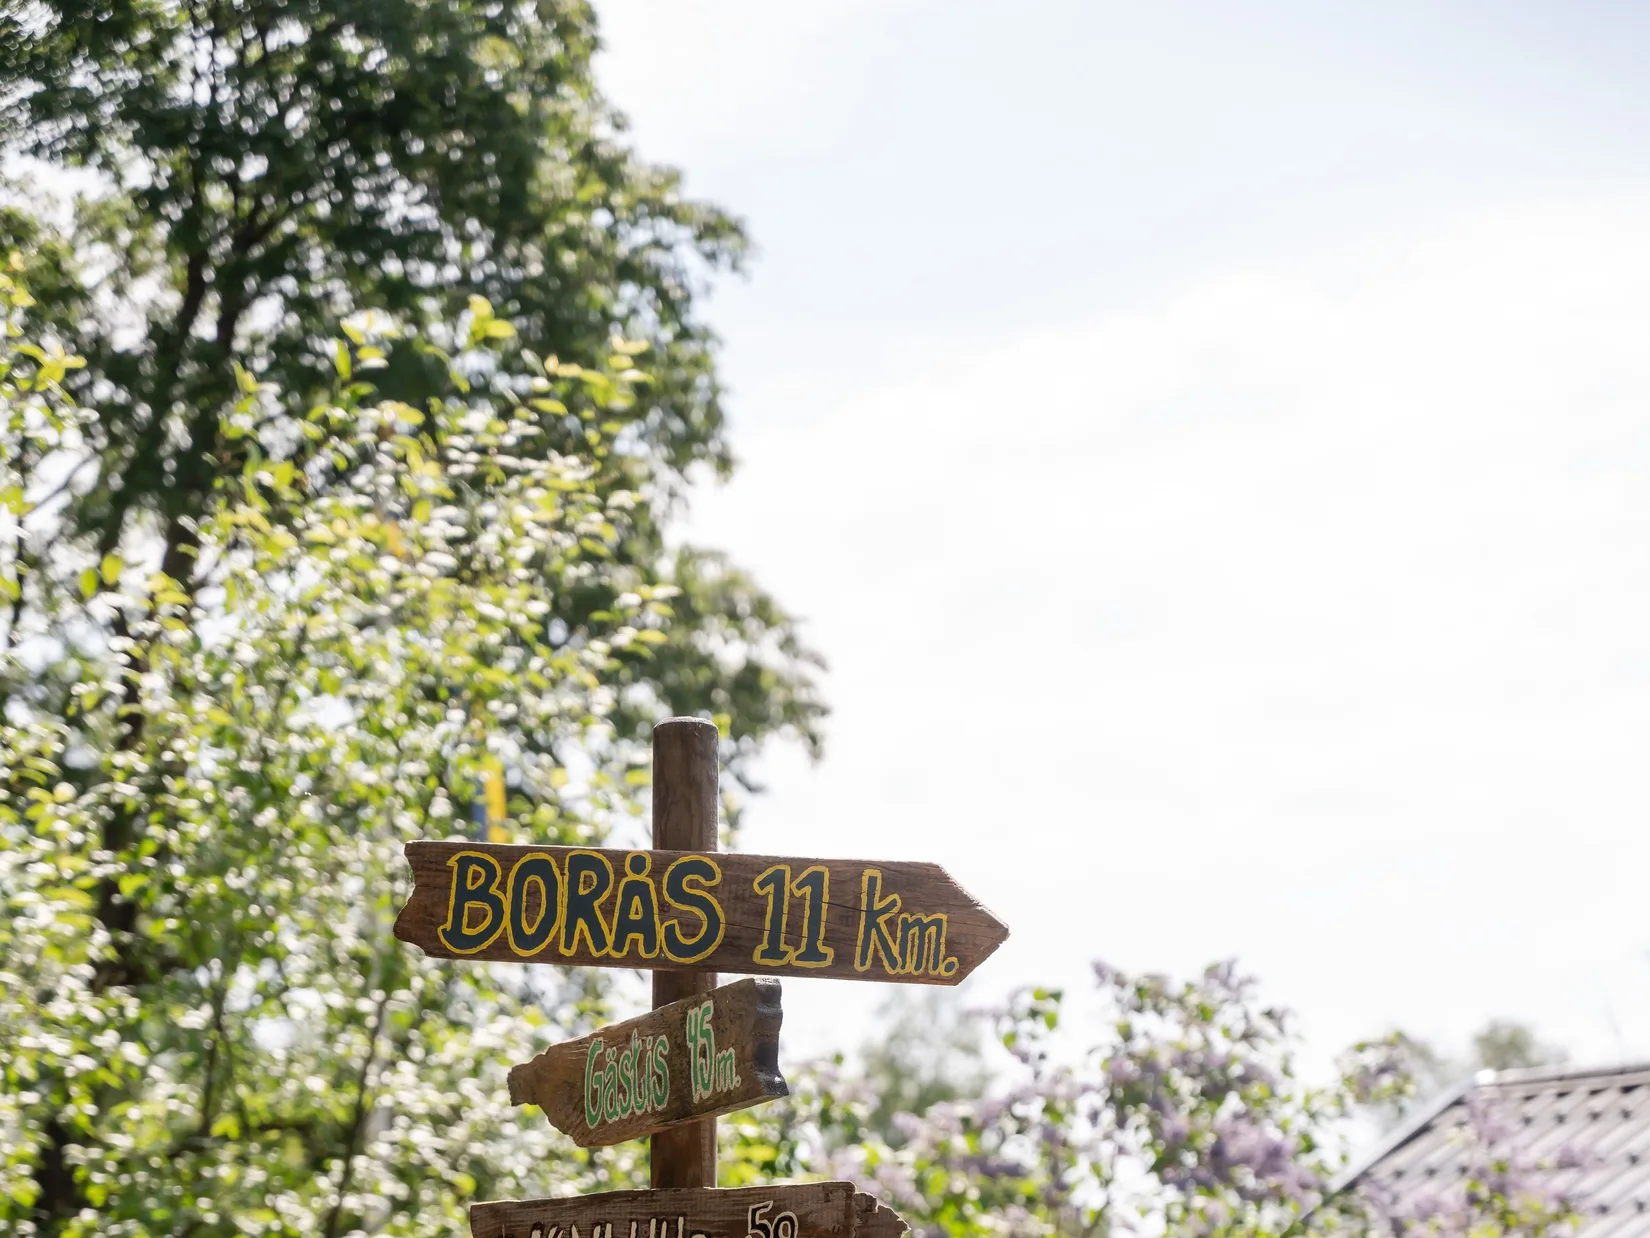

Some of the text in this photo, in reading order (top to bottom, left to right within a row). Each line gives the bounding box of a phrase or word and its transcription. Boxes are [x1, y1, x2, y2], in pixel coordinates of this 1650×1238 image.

[437, 850, 725, 963] BORÅS
[753, 864, 833, 968] 11
[585, 1028, 669, 1129] Gästis
